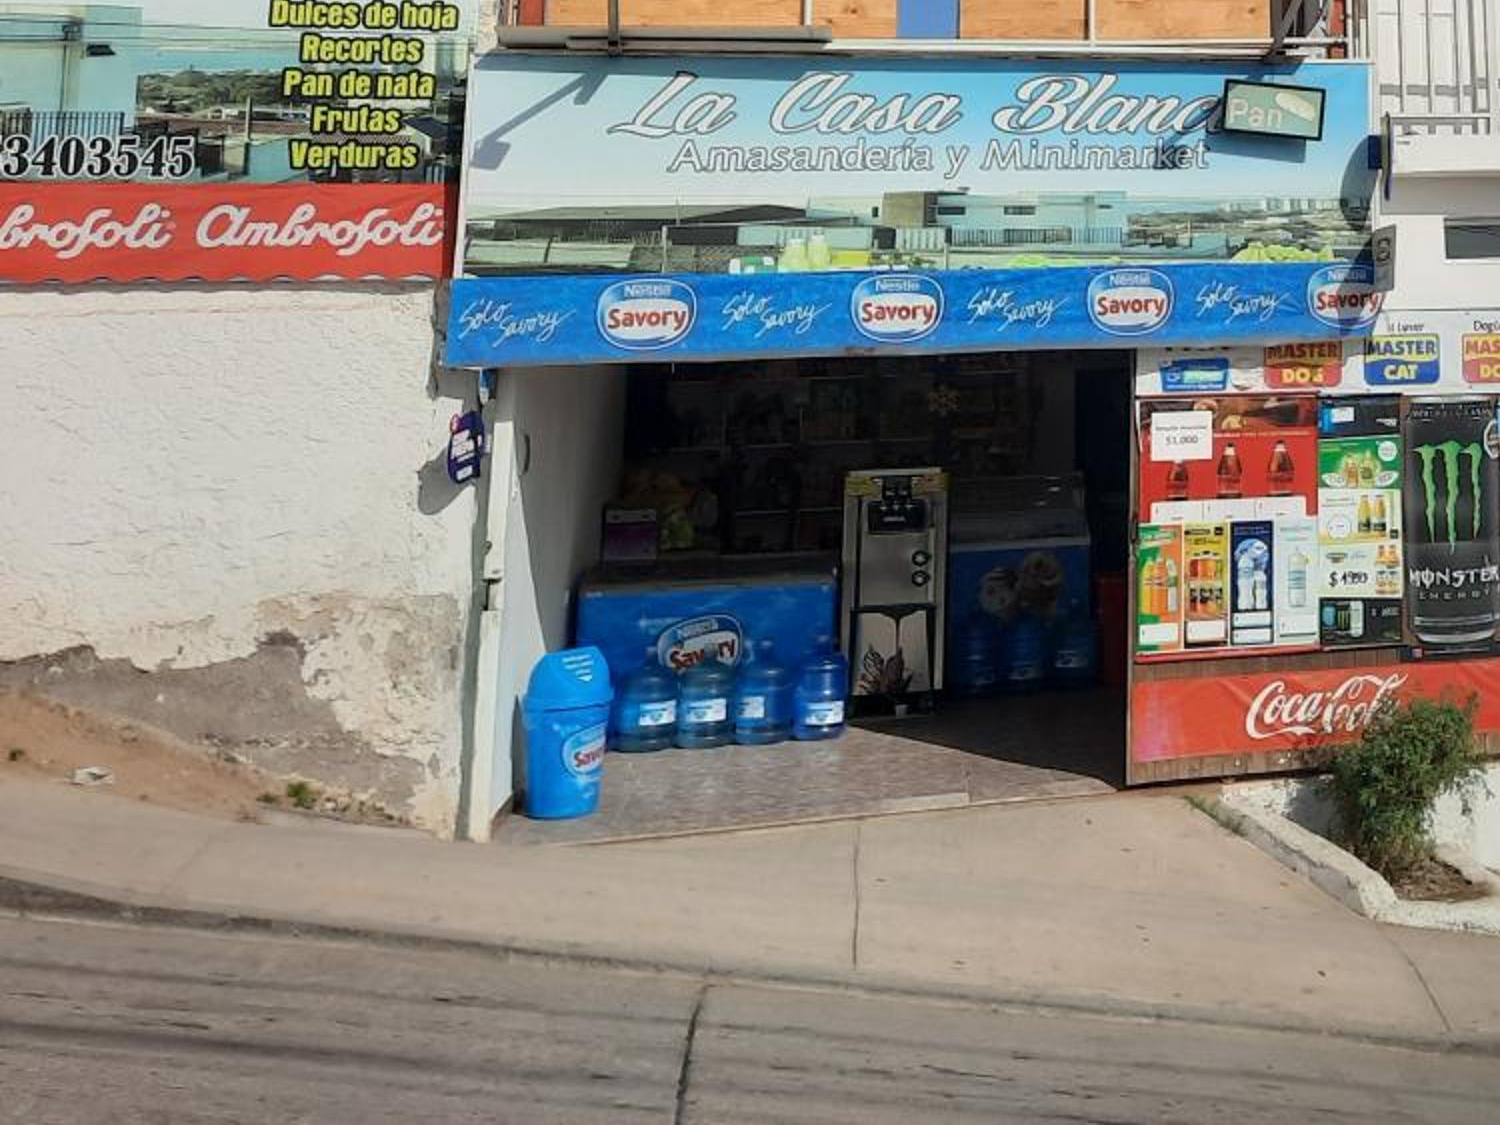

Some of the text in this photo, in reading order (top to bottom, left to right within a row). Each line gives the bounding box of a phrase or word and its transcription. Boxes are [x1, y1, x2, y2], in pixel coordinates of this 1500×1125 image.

[363, 0, 398, 28] de
[400, 0, 459, 30] hoja
[300, 32, 424, 64] Recortes
[282, 68, 436, 99] Pan de nata
[311, 103, 402, 134] Frutas
[607, 70, 1224, 138] La Casa Blanc
[1227, 97, 1282, 128] Pan
[2, 135, 196, 178] 3403545
[289, 139, 419, 170] Verduras
[667, 137, 1211, 180] Amasandería y Minimarket
[861, 302, 935, 325] Savory
[997, 296, 1071, 332] Savory
[1096, 296, 1166, 318] Savory
[1224, 291, 1291, 325] Savory
[1316, 290, 1379, 312] Savory
[491, 309, 576, 348] Savory
[607, 308, 688, 332] Savory
[754, 302, 832, 338] Savory
[1267, 342, 1341, 358] MASTER
[1367, 340, 1436, 355] MASTER
[1383, 364, 1419, 380] CAT
[669, 639, 736, 668] Savry
